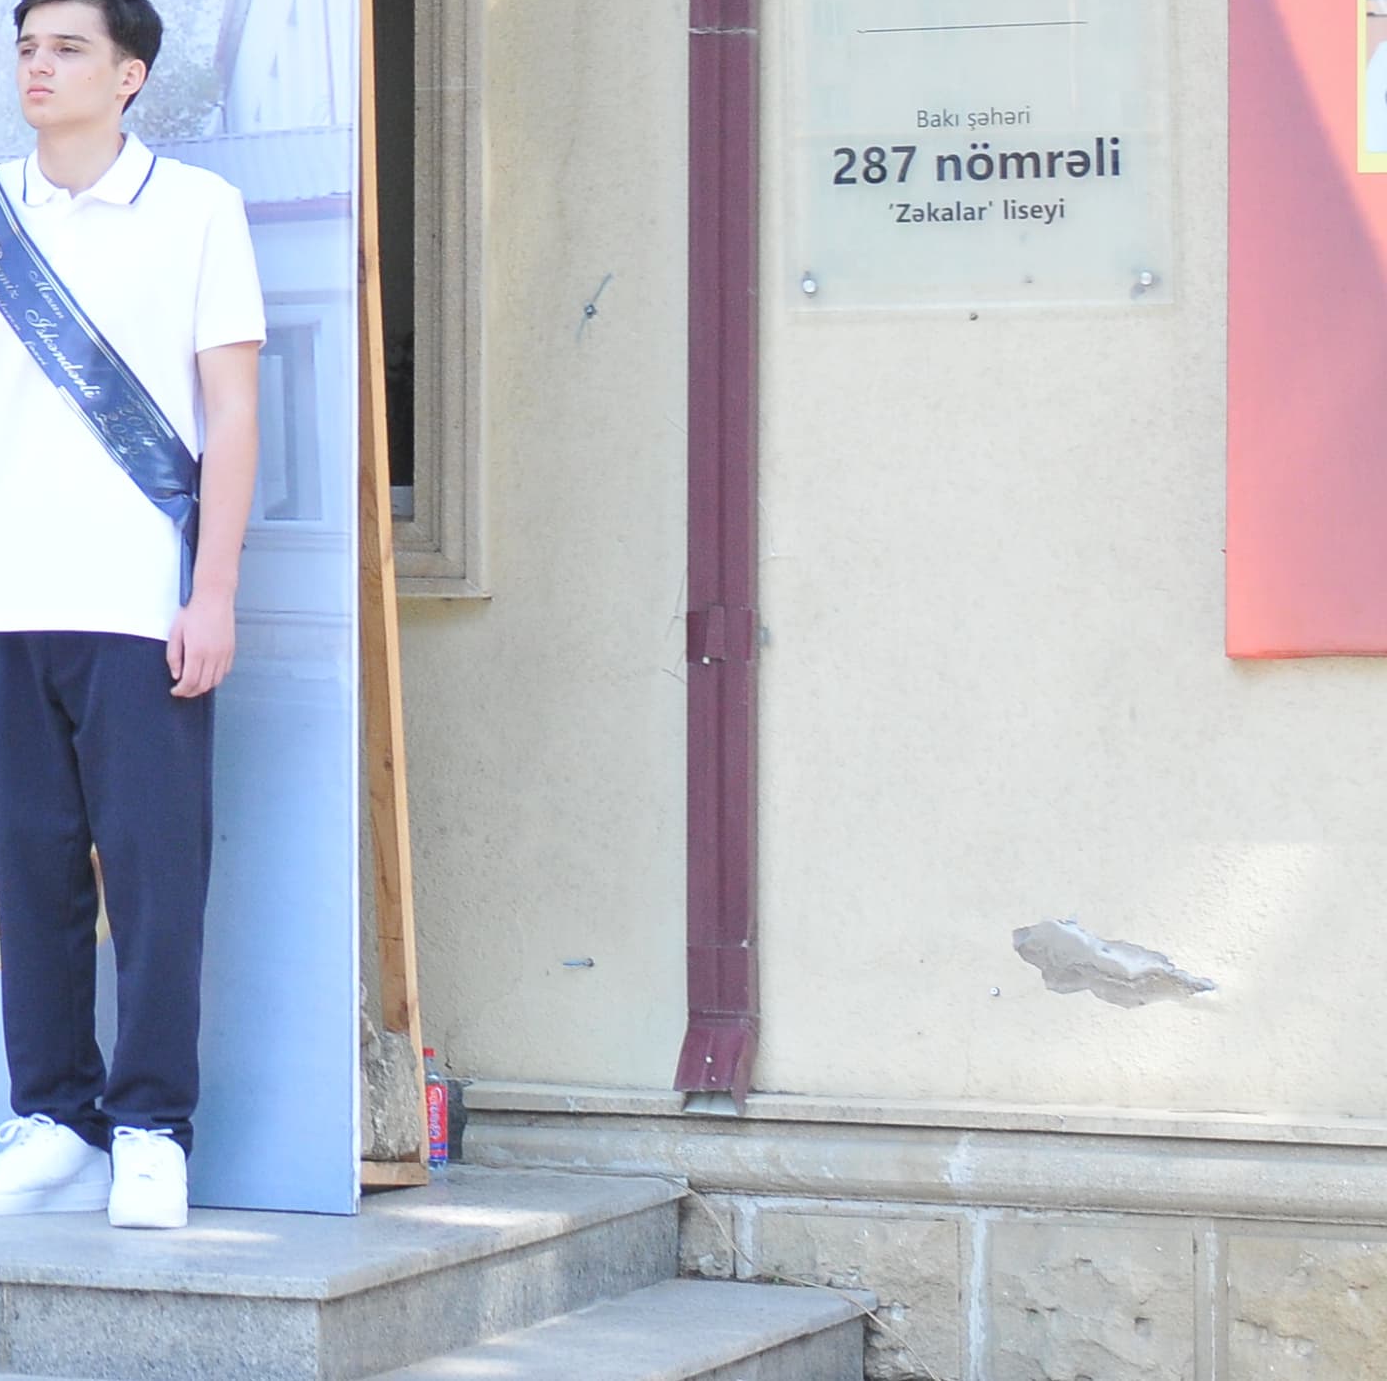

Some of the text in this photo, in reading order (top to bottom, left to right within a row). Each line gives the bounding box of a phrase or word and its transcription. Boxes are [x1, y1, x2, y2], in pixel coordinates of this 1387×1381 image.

[917, 106, 1031, 130] Bakı şəhəri
[832, 136, 1121, 186] 287 nömrəli
[1002, 198, 1065, 224] liseyi
